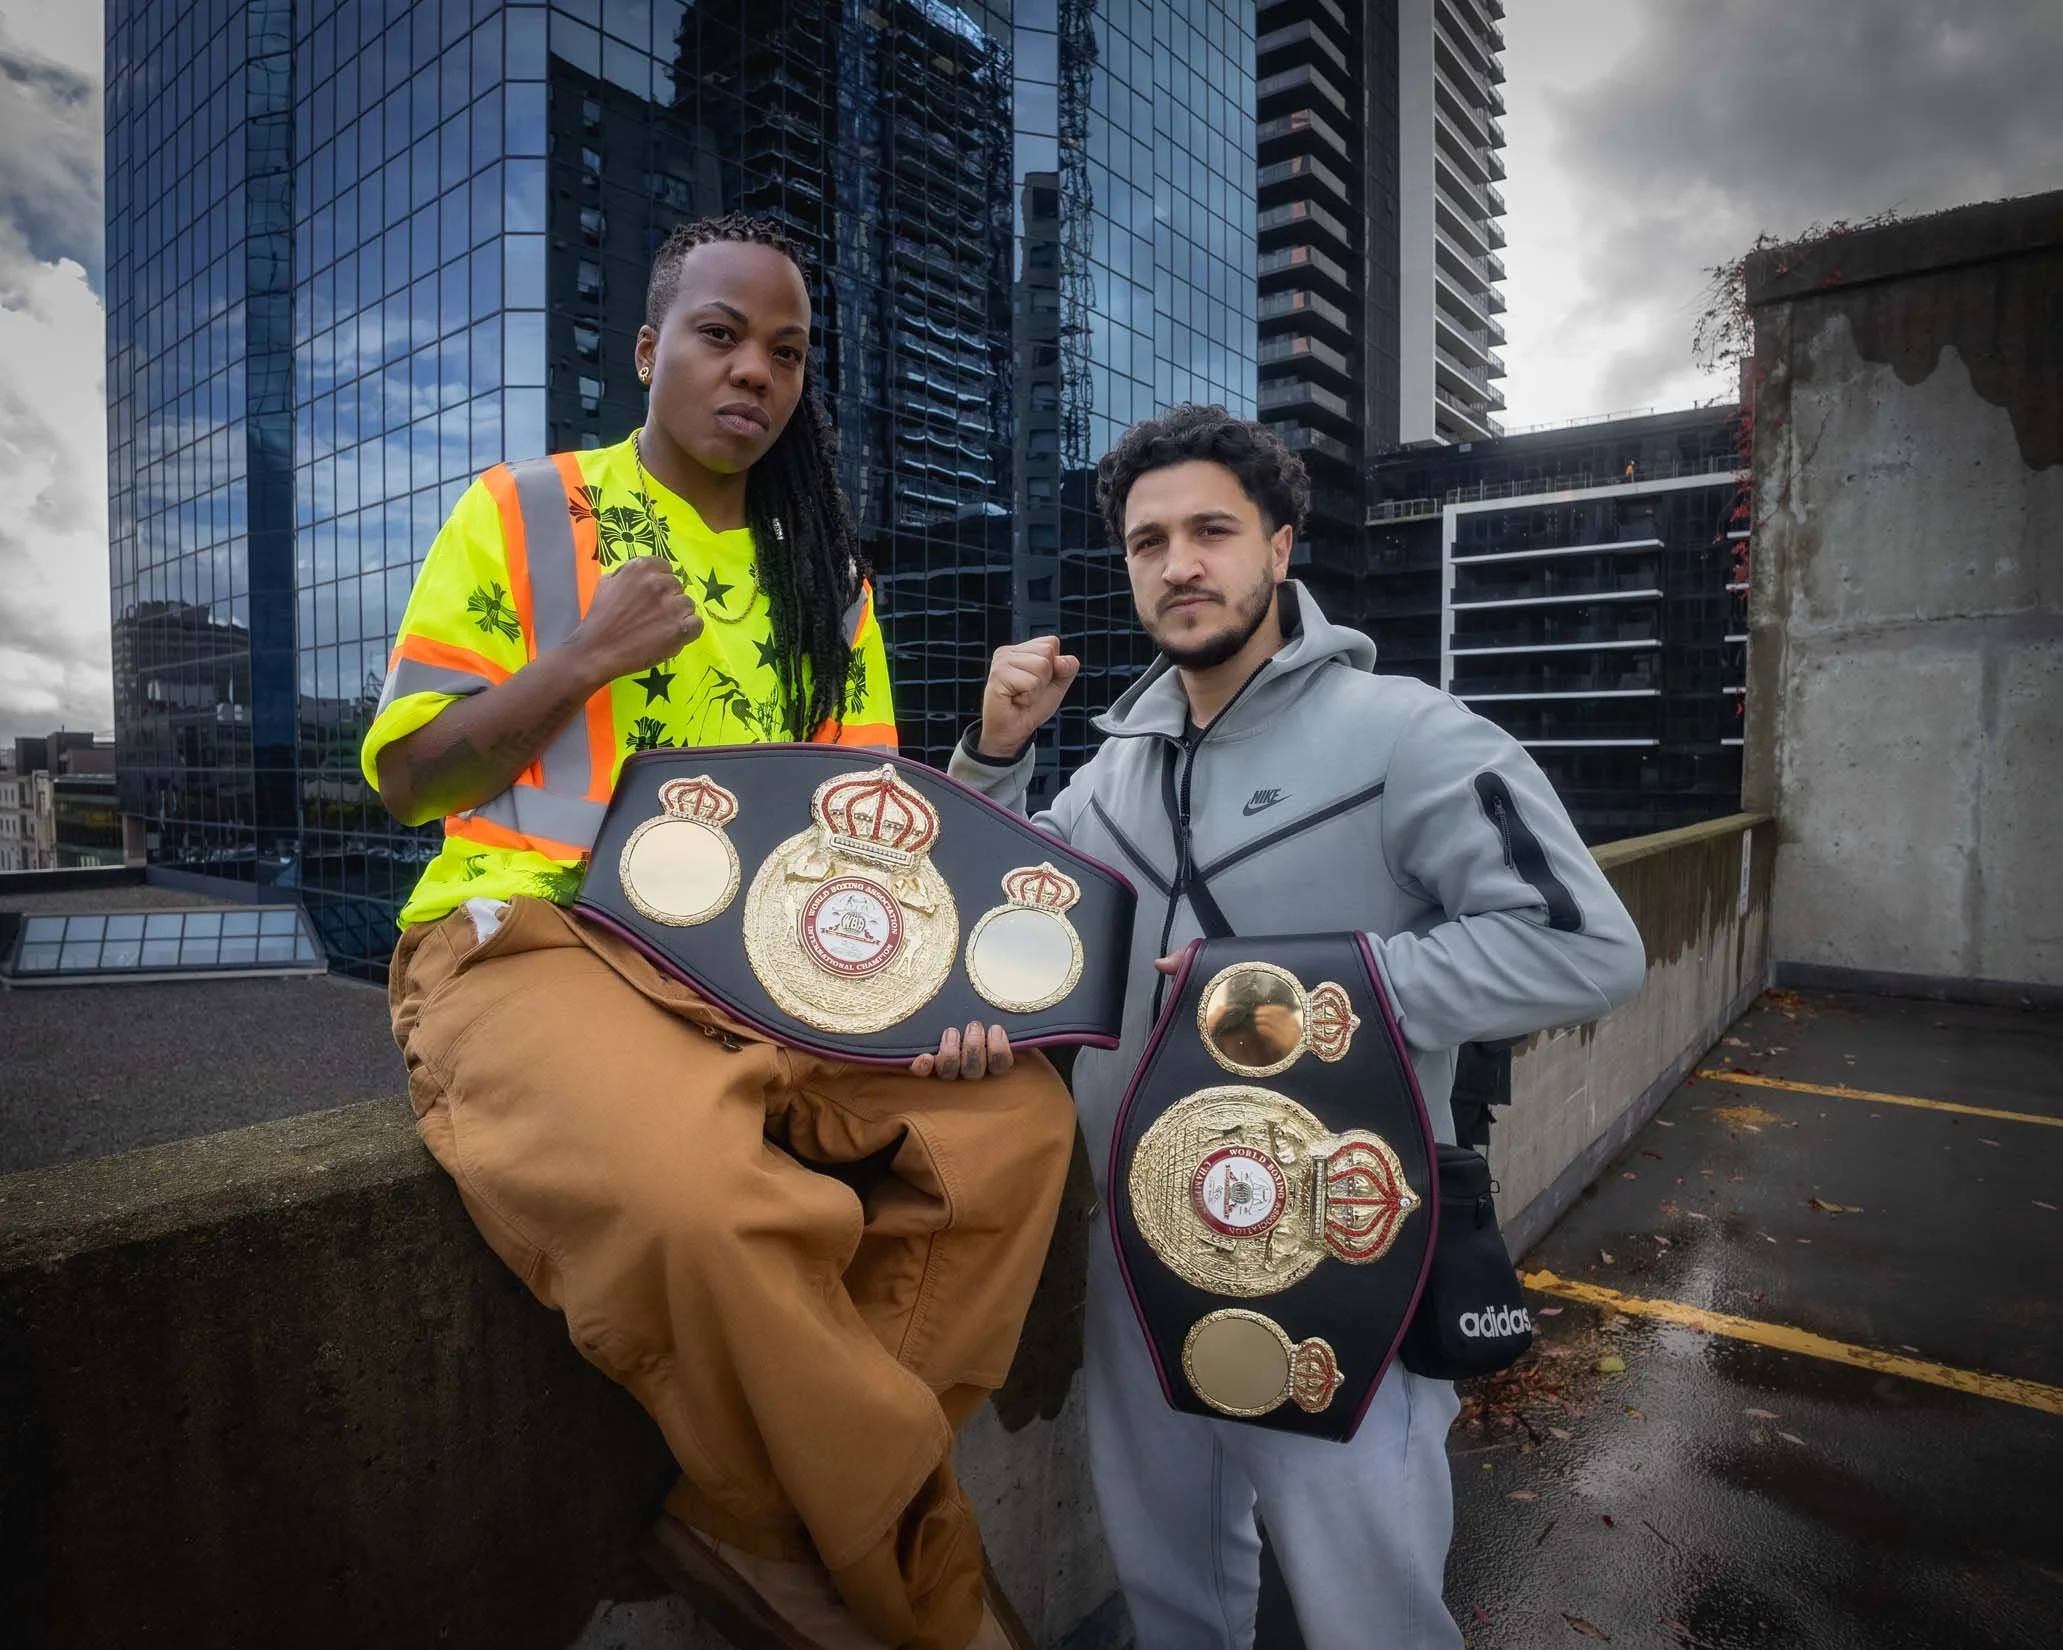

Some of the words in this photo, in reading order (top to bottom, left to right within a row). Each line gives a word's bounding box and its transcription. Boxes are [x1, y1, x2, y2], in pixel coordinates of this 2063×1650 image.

[1250, 788, 1282, 805] NIKE
[808, 890, 830, 917] WORLD
[831, 882, 865, 893] BOXING
[865, 886, 898, 935] ASSOCIATION
[842, 914, 865, 932] WBA
[856, 943, 894, 971] CHAMPION
[1229, 1148, 1267, 1163] WORLD
[1267, 1163, 1285, 1198] BOXING
[1228, 1203, 1281, 1235] ASSOCIATION
[1459, 1304, 1532, 1337] adidas
